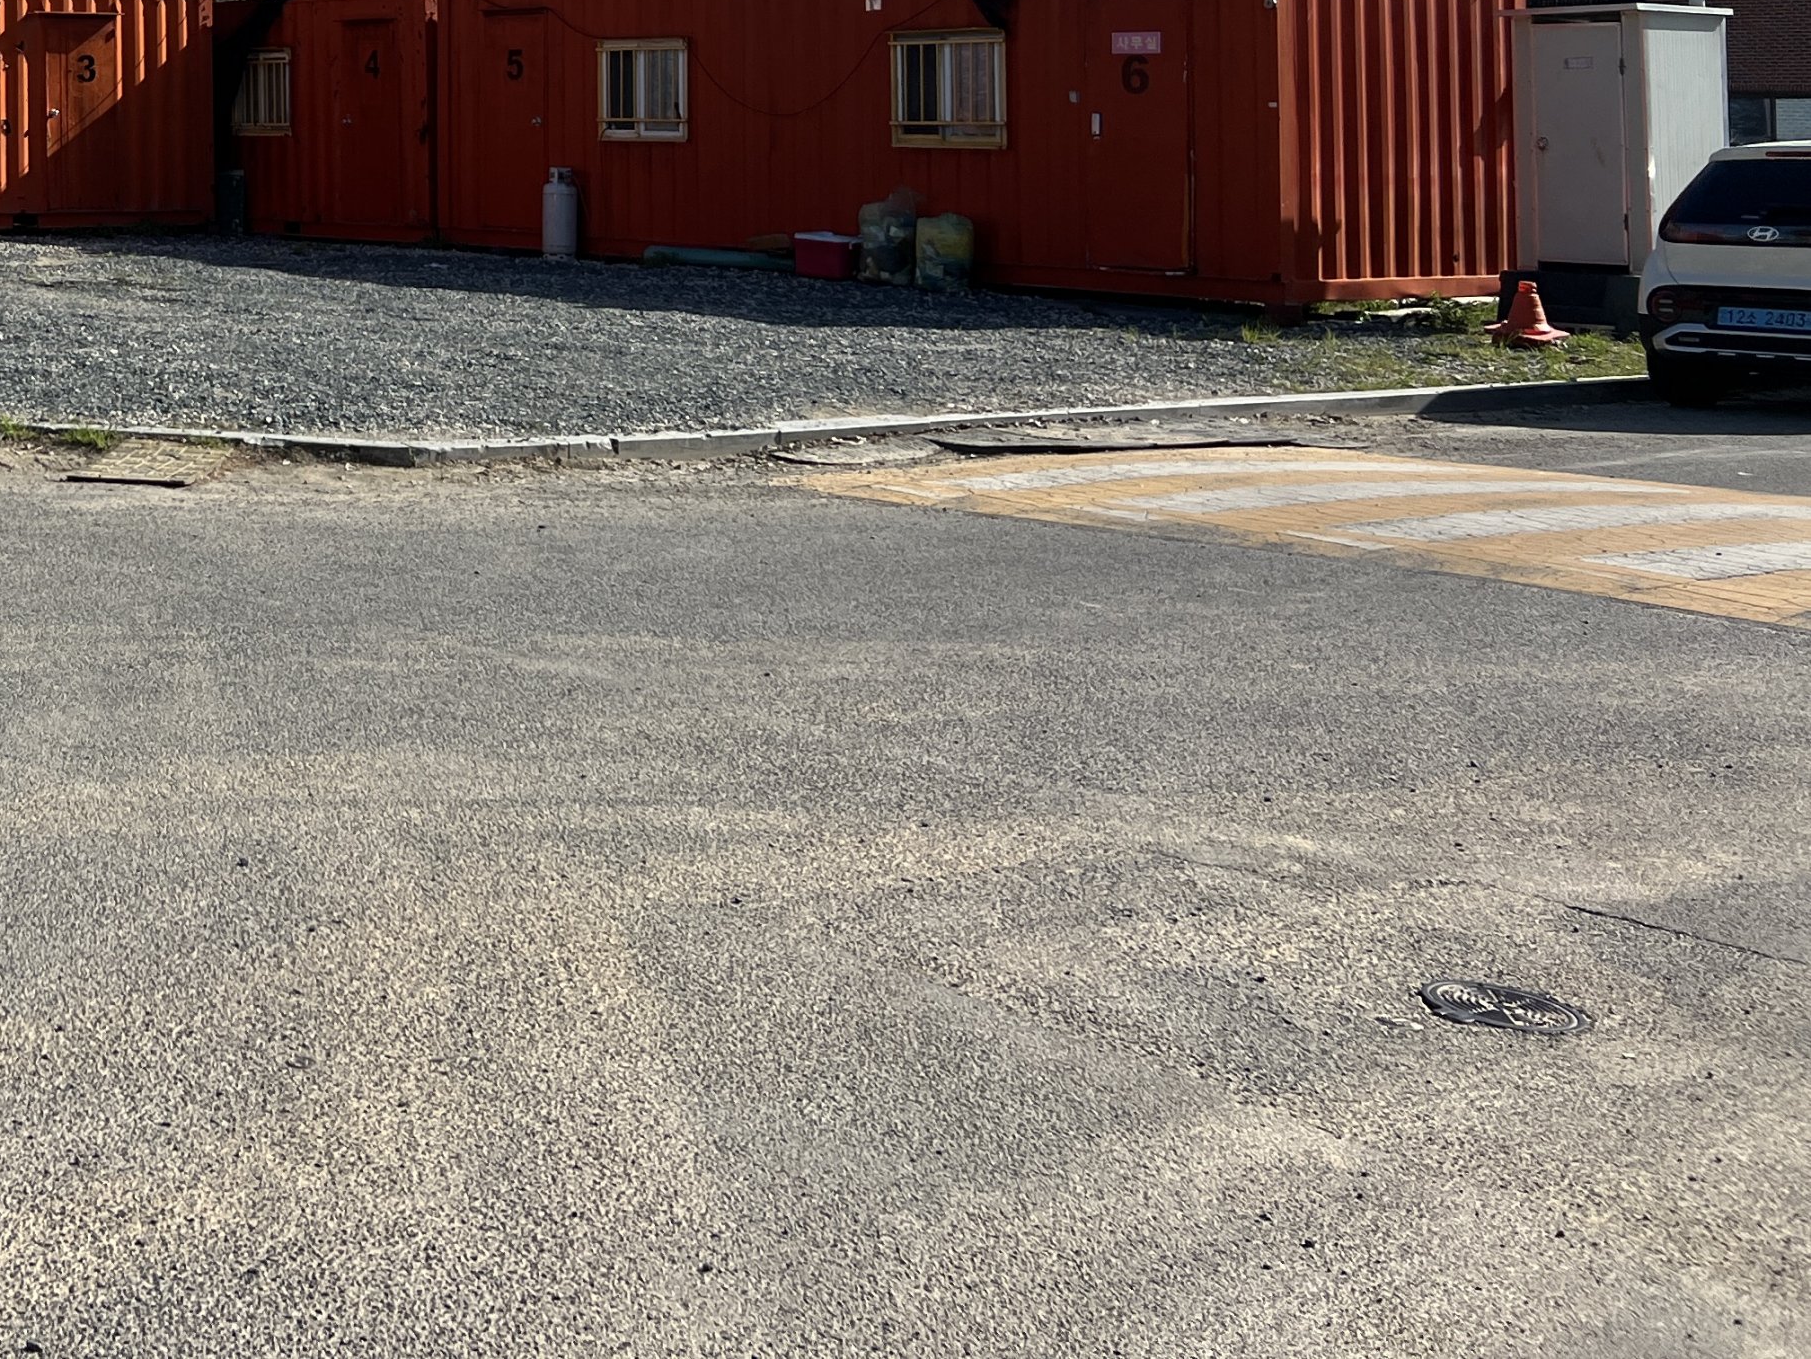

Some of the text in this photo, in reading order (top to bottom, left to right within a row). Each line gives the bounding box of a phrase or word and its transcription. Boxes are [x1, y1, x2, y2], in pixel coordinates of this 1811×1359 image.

[1116, 35, 1158, 51] 사무실
[76, 53, 96, 83] 3
[364, 49, 381, 80] 4
[505, 48, 525, 81] 5
[1121, 54, 1150, 95] 6
[1726, 309, 1807, 328] 12소 2403
